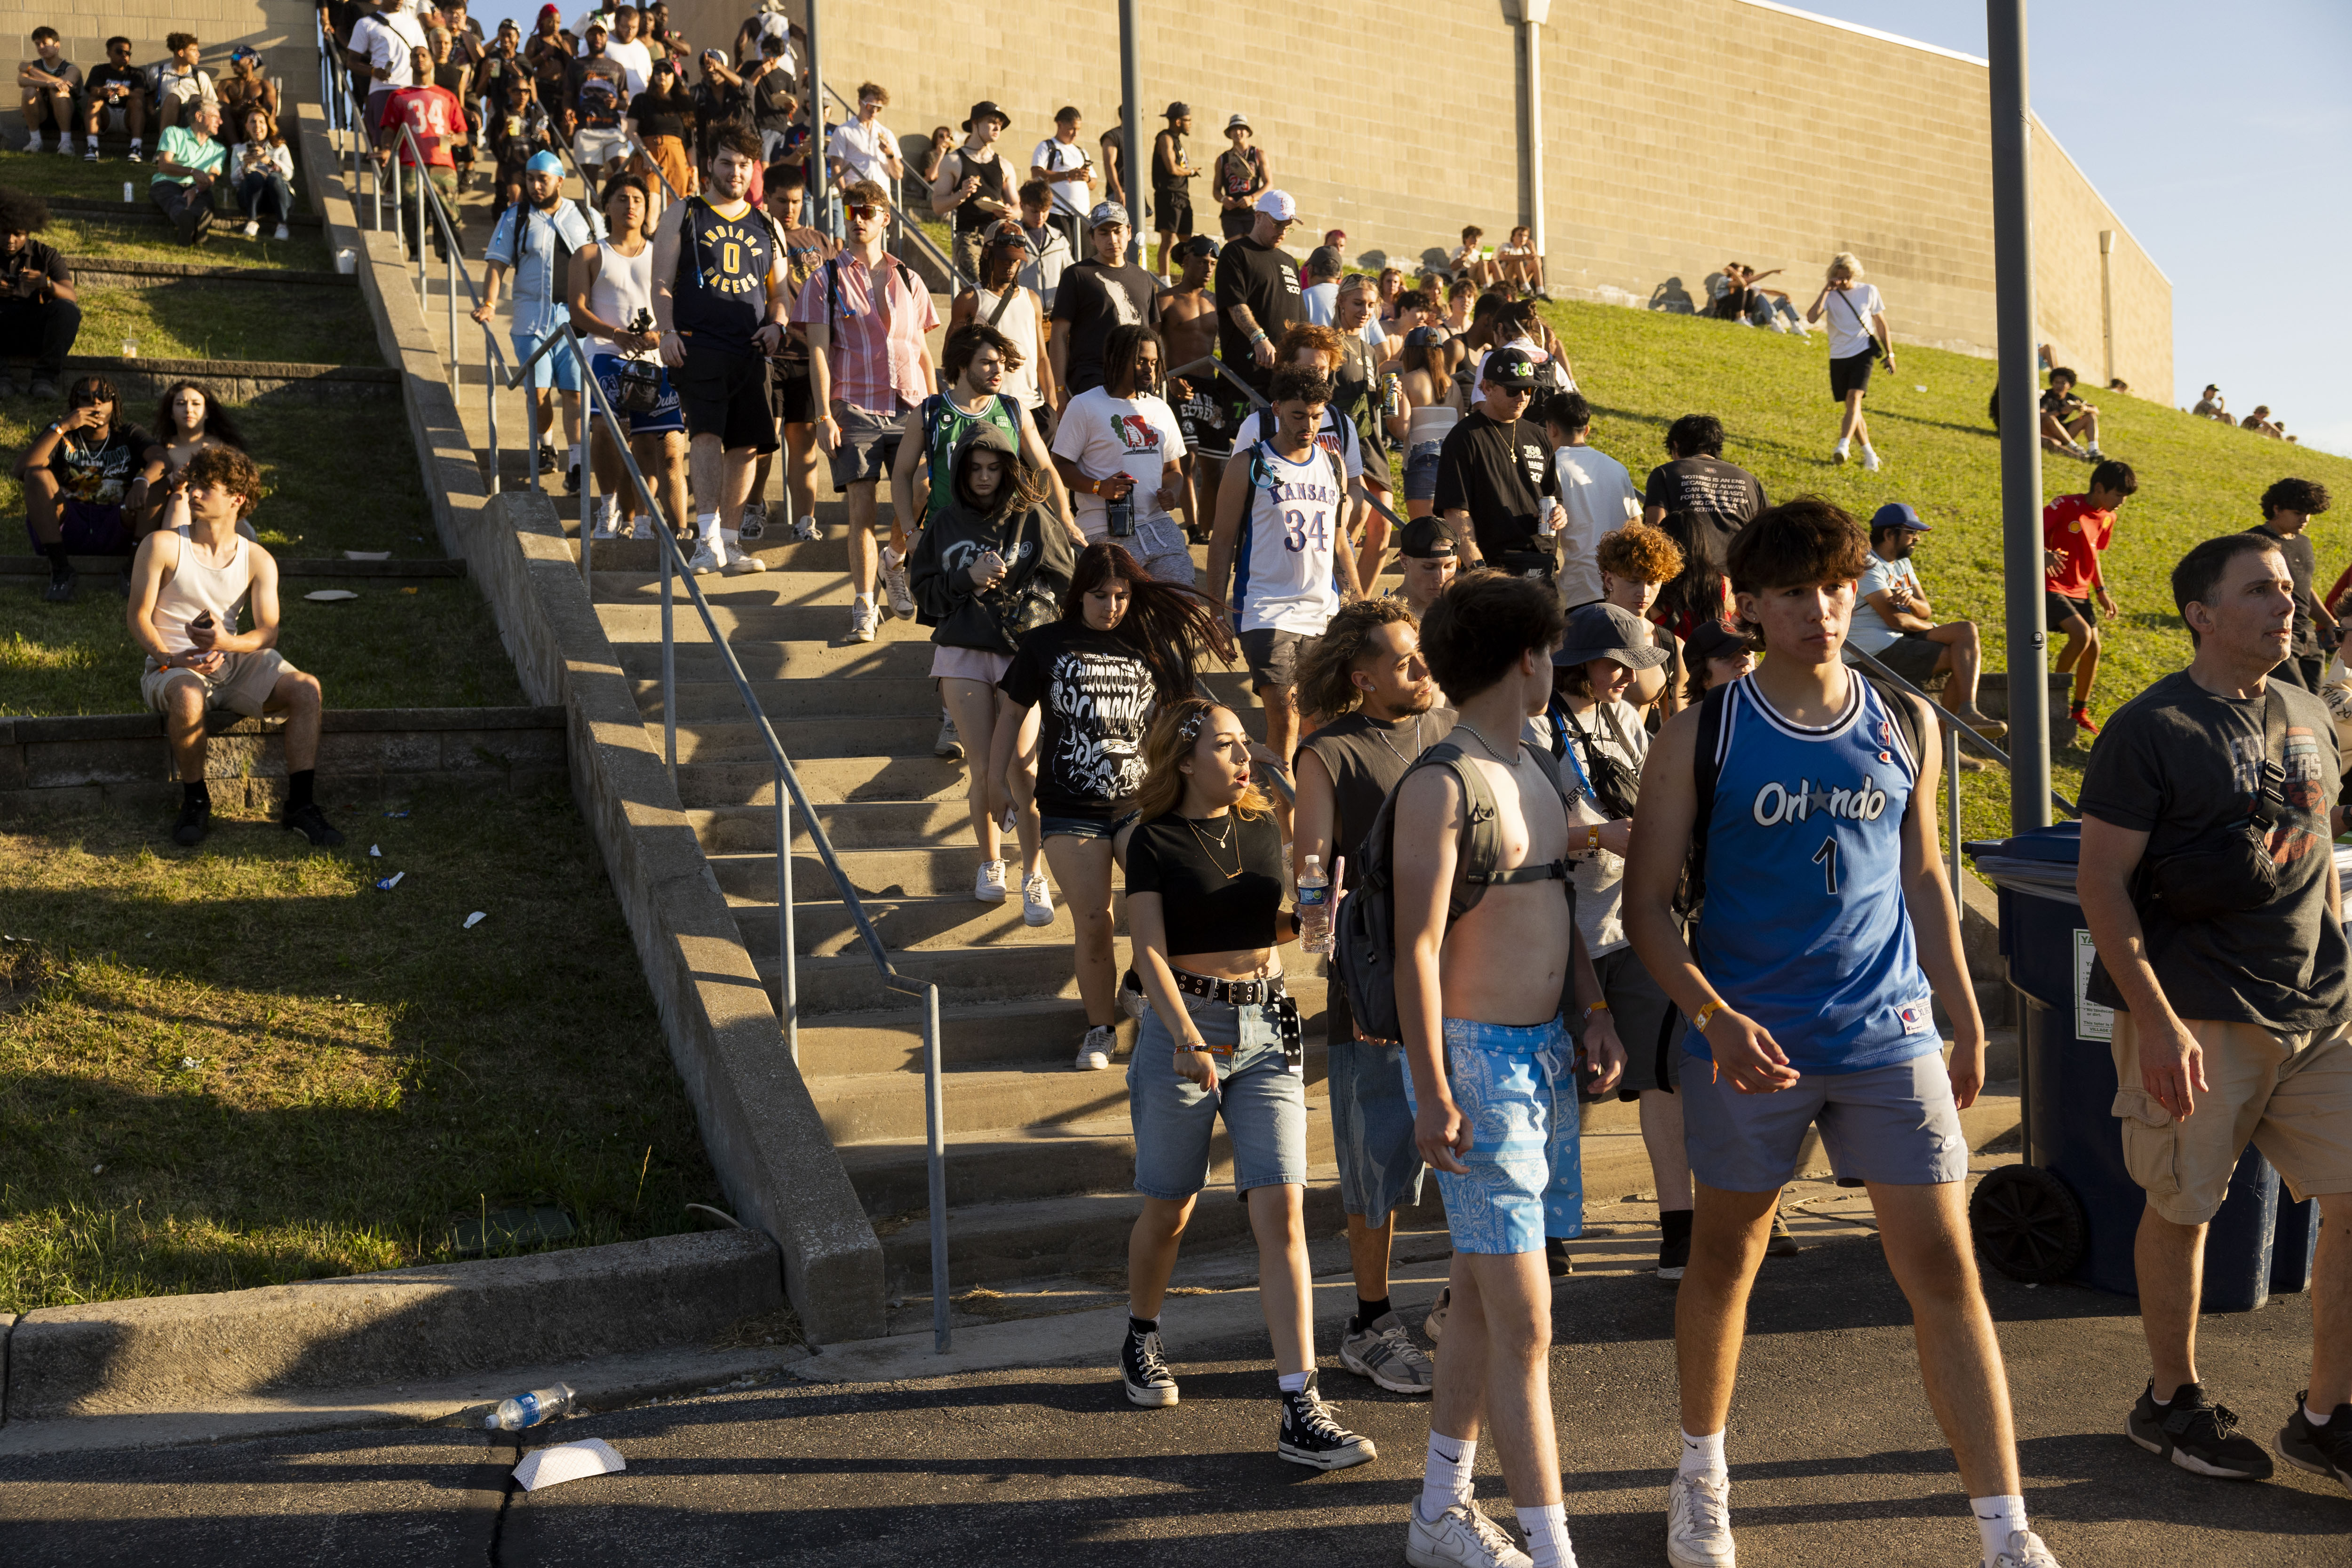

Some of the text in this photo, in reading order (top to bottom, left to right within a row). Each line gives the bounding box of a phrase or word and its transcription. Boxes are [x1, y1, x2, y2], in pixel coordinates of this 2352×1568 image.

[407, 98, 445, 135] 34
[699, 225, 763, 257] INDIANA
[723, 242, 740, 274] 0
[703, 266, 758, 294] PACERS
[1267, 483, 1335, 507] KANSAS
[1284, 509, 1328, 553] 34
[1526, 568, 1543, 577] NIKE
[1812, 835, 1838, 894] 1
